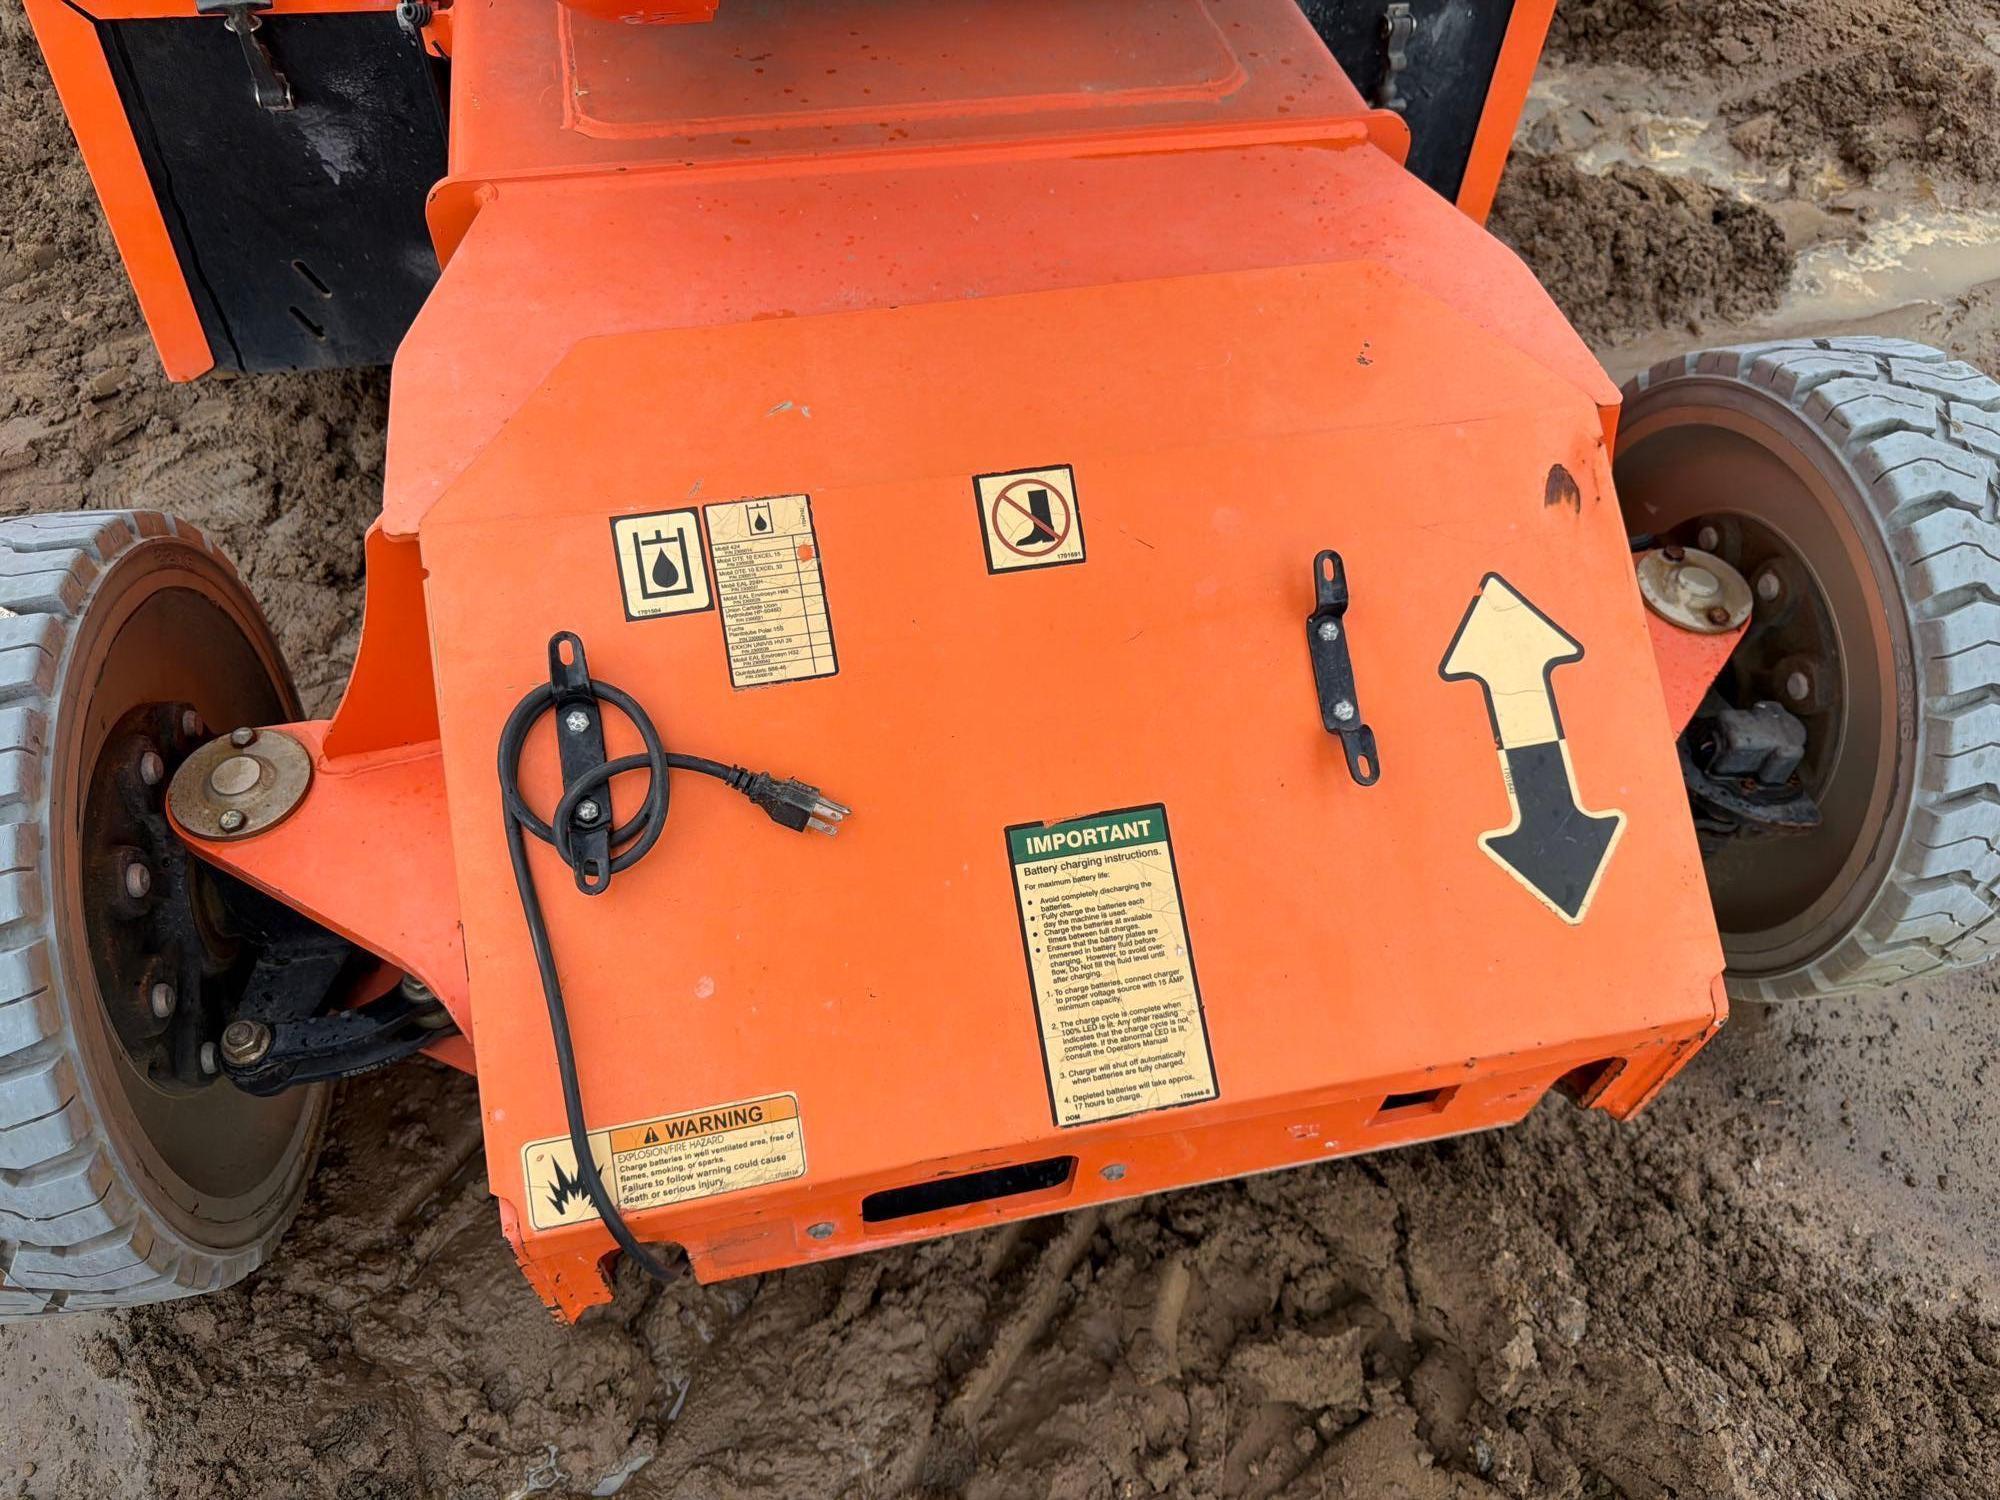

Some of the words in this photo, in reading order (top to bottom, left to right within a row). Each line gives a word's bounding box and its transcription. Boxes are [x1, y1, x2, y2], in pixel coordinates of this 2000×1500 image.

[1025, 819, 1153, 854] IMPORTANT
[1023, 865, 1058, 876] Battery
[1060, 858, 1102, 870] charging
[1104, 849, 1161, 864] instructions.
[1038, 879, 1071, 888] maximum
[1072, 875, 1096, 883] battery
[1039, 895, 1059, 904] Avoid
[1061, 890, 1098, 900] completely
[1099, 884, 1139, 894] discharging
[1040, 903, 1072, 912] batteries.
[1041, 912, 1058, 920] Fully
[1059, 909, 1083, 917] charge
[1097, 902, 1127, 911] batteries
[1128, 898, 1144, 906] each
[1070, 914, 1099, 923] machine
[1109, 909, 1127, 917] used.
[1044, 928, 1069, 936] Charge
[1083, 921, 1113, 929] batteries
[1123, 914, 1152, 923] available
[1068, 931, 1097, 940] between
[1111, 925, 1140, 933] charges.
[1046, 944, 1071, 952] Ensure
[1099, 935, 1124, 943] battery
[1125, 931, 1145, 940] plates
[1048, 949, 1083, 960] immersed
[1092, 944, 1116, 952] battery
[1118, 940, 1132, 948] fluid
[1134, 938, 1156, 946] before
[1050, 958, 1082, 967] charging.
[1086, 953, 1118, 961] However,
[1128, 946, 1146, 955] avoid
[1133, 954, 1149, 962] level
[1150, 951, 1165, 959] until
[1065, 986, 1088, 994] charge
[1090, 980, 1123, 990] batteries,
[1124, 974, 1152, 984] connect
[1154, 971, 1180, 979] charger
[1070, 972, 1102, 981] charging.
[1065, 994, 1088, 1003] proper
[1090, 990, 1115, 998] voltage
[1139, 981, 1156, 989] with
[1168, 977, 1184, 985] AMP
[1057, 1002, 1090, 1012] minimum
[1060, 1020, 1073, 1028] The
[1075, 1017, 1099, 1025] charge
[1101, 1013, 1119, 1021] cycle
[1129, 1005, 1161, 1016] complete
[1065, 1050, 1092, 1060] consult
[1106, 1043, 1141, 1054] Operators
[1142, 1037, 1168, 1047] Manual
[1068, 1068, 1097, 1077] Charger
[1099, 1064, 1111, 1072] will
[1112, 1061, 1127, 1069] shut
[1140, 1052, 1186, 1064] automatically
[1092, 1071, 1123, 1081] batteries
[1154, 1060, 1184, 1070] charged.
[1072, 1091, 1105, 1102] Depleted
[1106, 1086, 1137, 1096] batteries
[1151, 1080, 1167, 1088] take
[1168, 1076, 1195, 1086] approx.
[1084, 1100, 1105, 1108] hours
[1116, 1094, 1142, 1102] charge.
[666, 1106, 764, 1139] WARNING
[617, 1142, 687, 1163] EXPLOSION/FIRE
[689, 1135, 725, 1149] HAZARD
[619, 1162, 647, 1172] Charge
[649, 1155, 682, 1166] batteries
[694, 1149, 709, 1157] well
[712, 1141, 748, 1154] ventilated
[749, 1139, 767, 1147] area,
[786, 1132, 794, 1140] of
[620, 1172, 648, 1182] flames,
[650, 1165, 686, 1176] smoking,
[698, 1157, 725, 1167] sparks.
[621, 1181, 653, 1192] Failure
[666, 1173, 695, 1184] follow
[697, 1166, 732, 1178] warning
[733, 1160, 758, 1171] could
[760, 1156, 787, 1166] cause
[623, 1192, 649, 1203] death
[662, 1185, 696, 1196] serious
[698, 1179, 725, 1189] injury.
